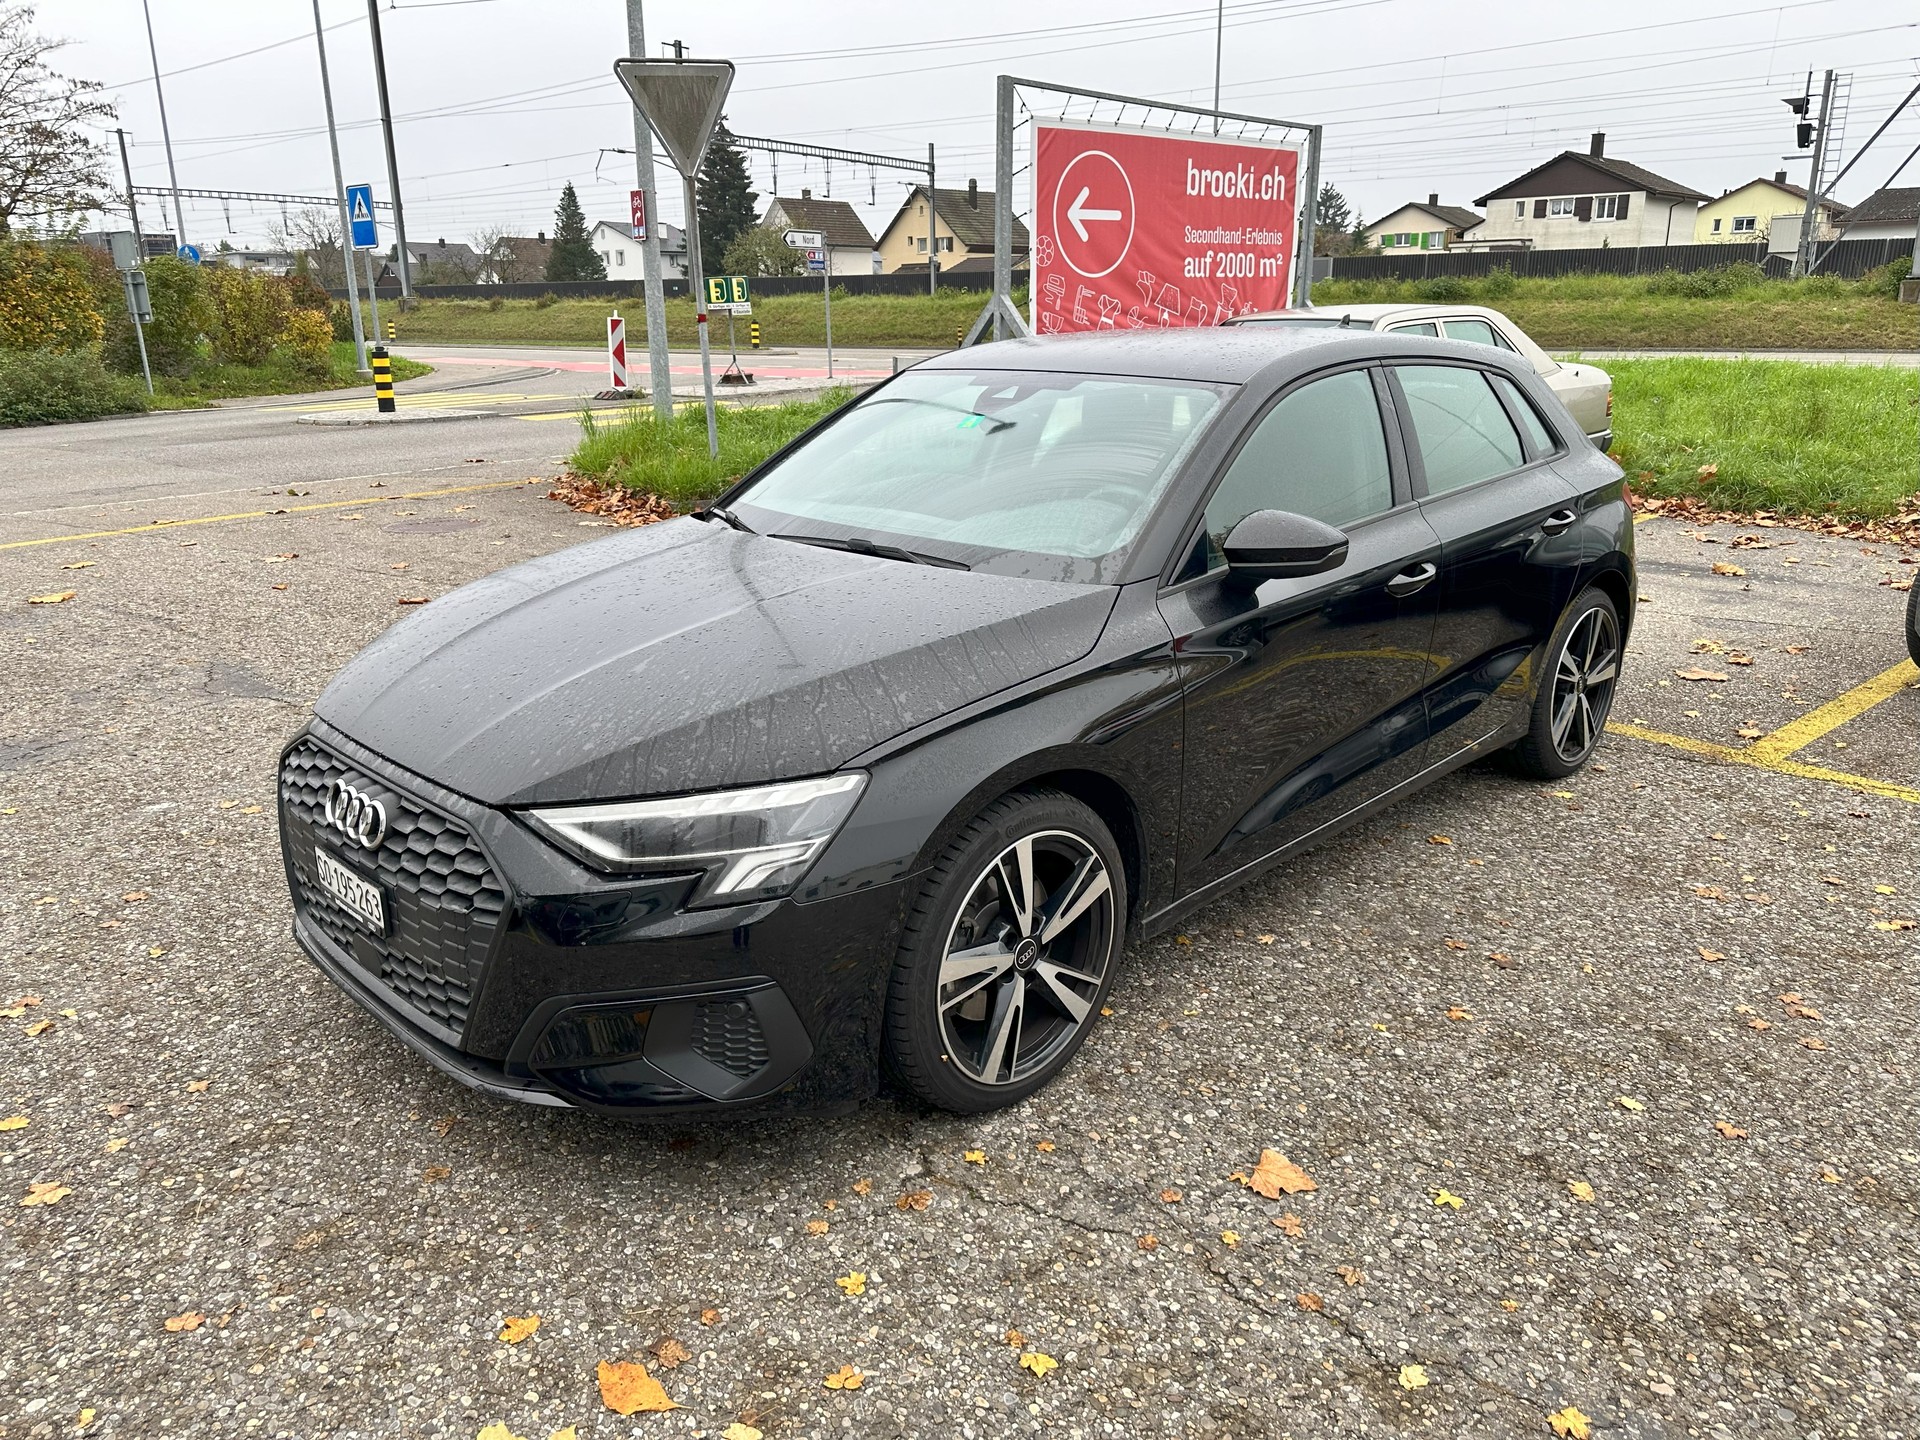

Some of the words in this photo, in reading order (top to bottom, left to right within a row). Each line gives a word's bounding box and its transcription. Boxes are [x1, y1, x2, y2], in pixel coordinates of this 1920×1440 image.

[1186, 158, 1286, 201] brocki.ch
[802, 234, 815, 245] Nord
[1184, 225, 1283, 246] Secondhand-Erlebnis
[1184, 250, 1214, 278] auf
[1216, 252, 1255, 278] 2000
[1260, 253, 1283, 278] m²
